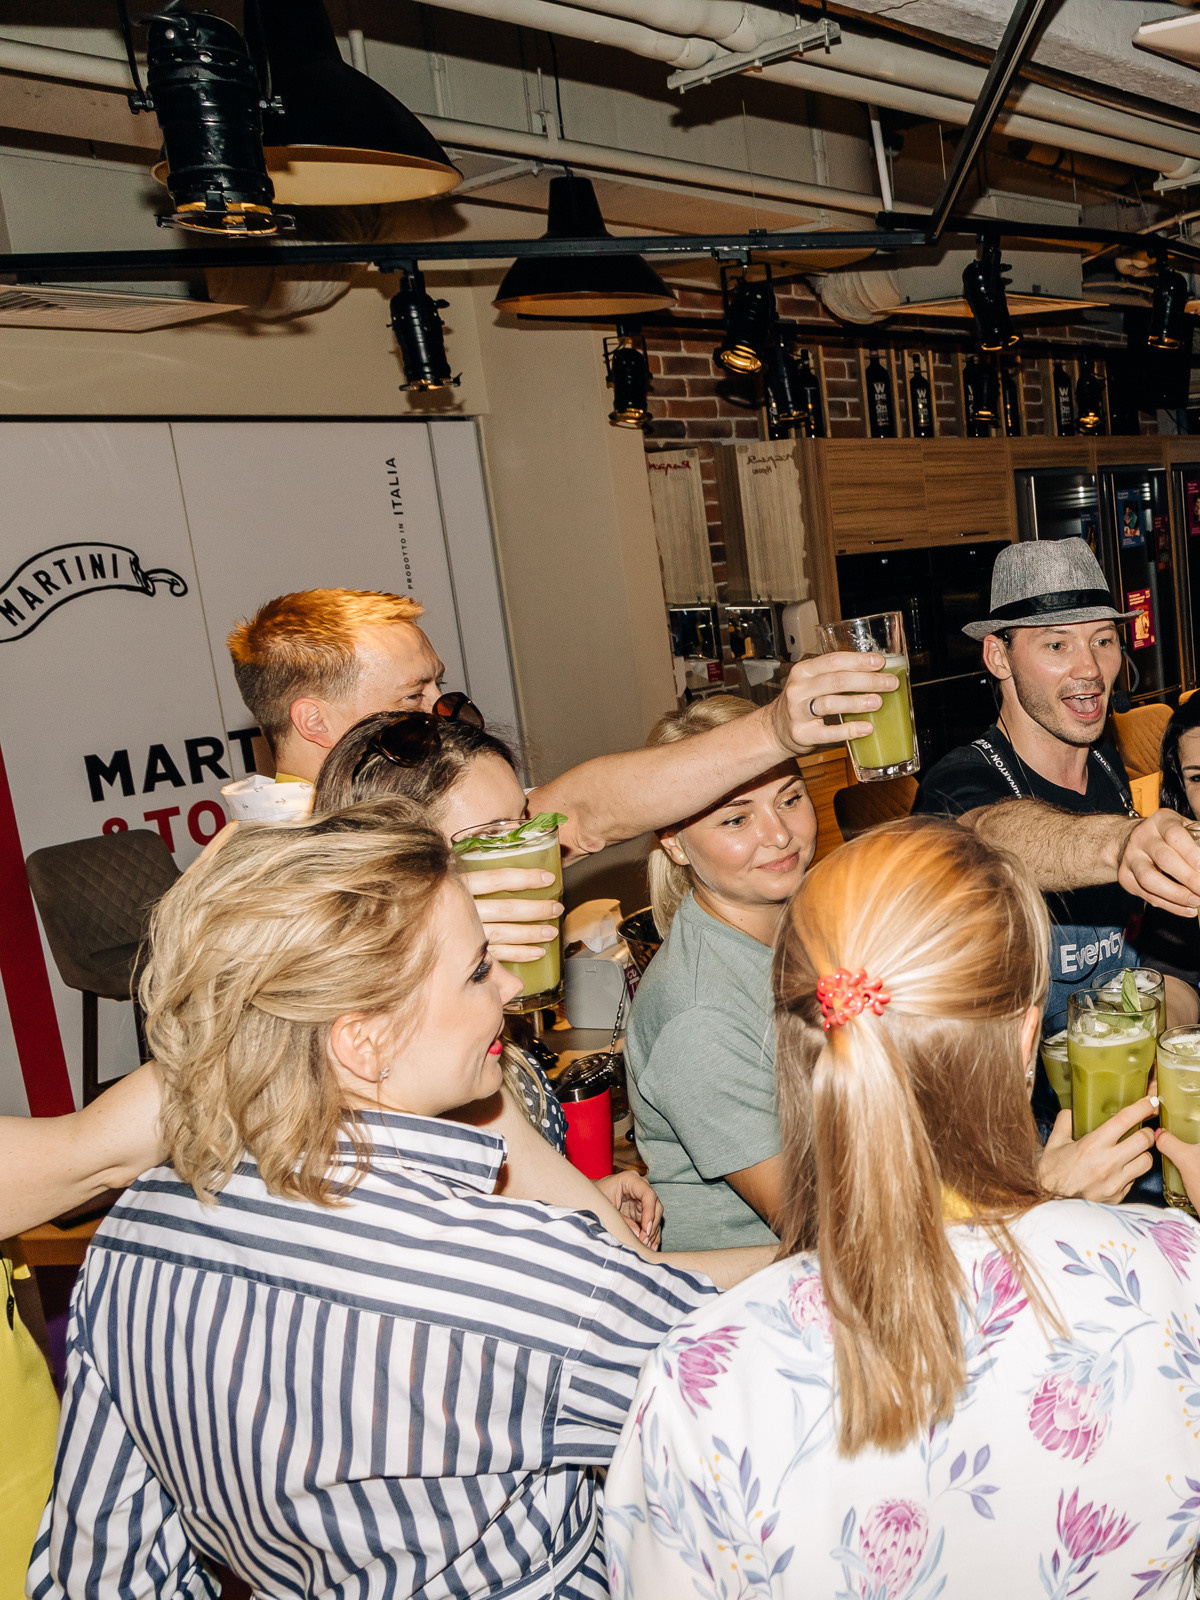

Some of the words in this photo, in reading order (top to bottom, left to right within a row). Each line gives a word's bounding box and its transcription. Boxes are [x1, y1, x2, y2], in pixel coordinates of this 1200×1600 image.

[385, 457, 404, 515] ITALIA
[398, 523, 405, 533] IN
[0, 553, 119, 627] MARTINI
[400, 538, 414, 590] PRODOTTO
[84, 727, 262, 803] MART
